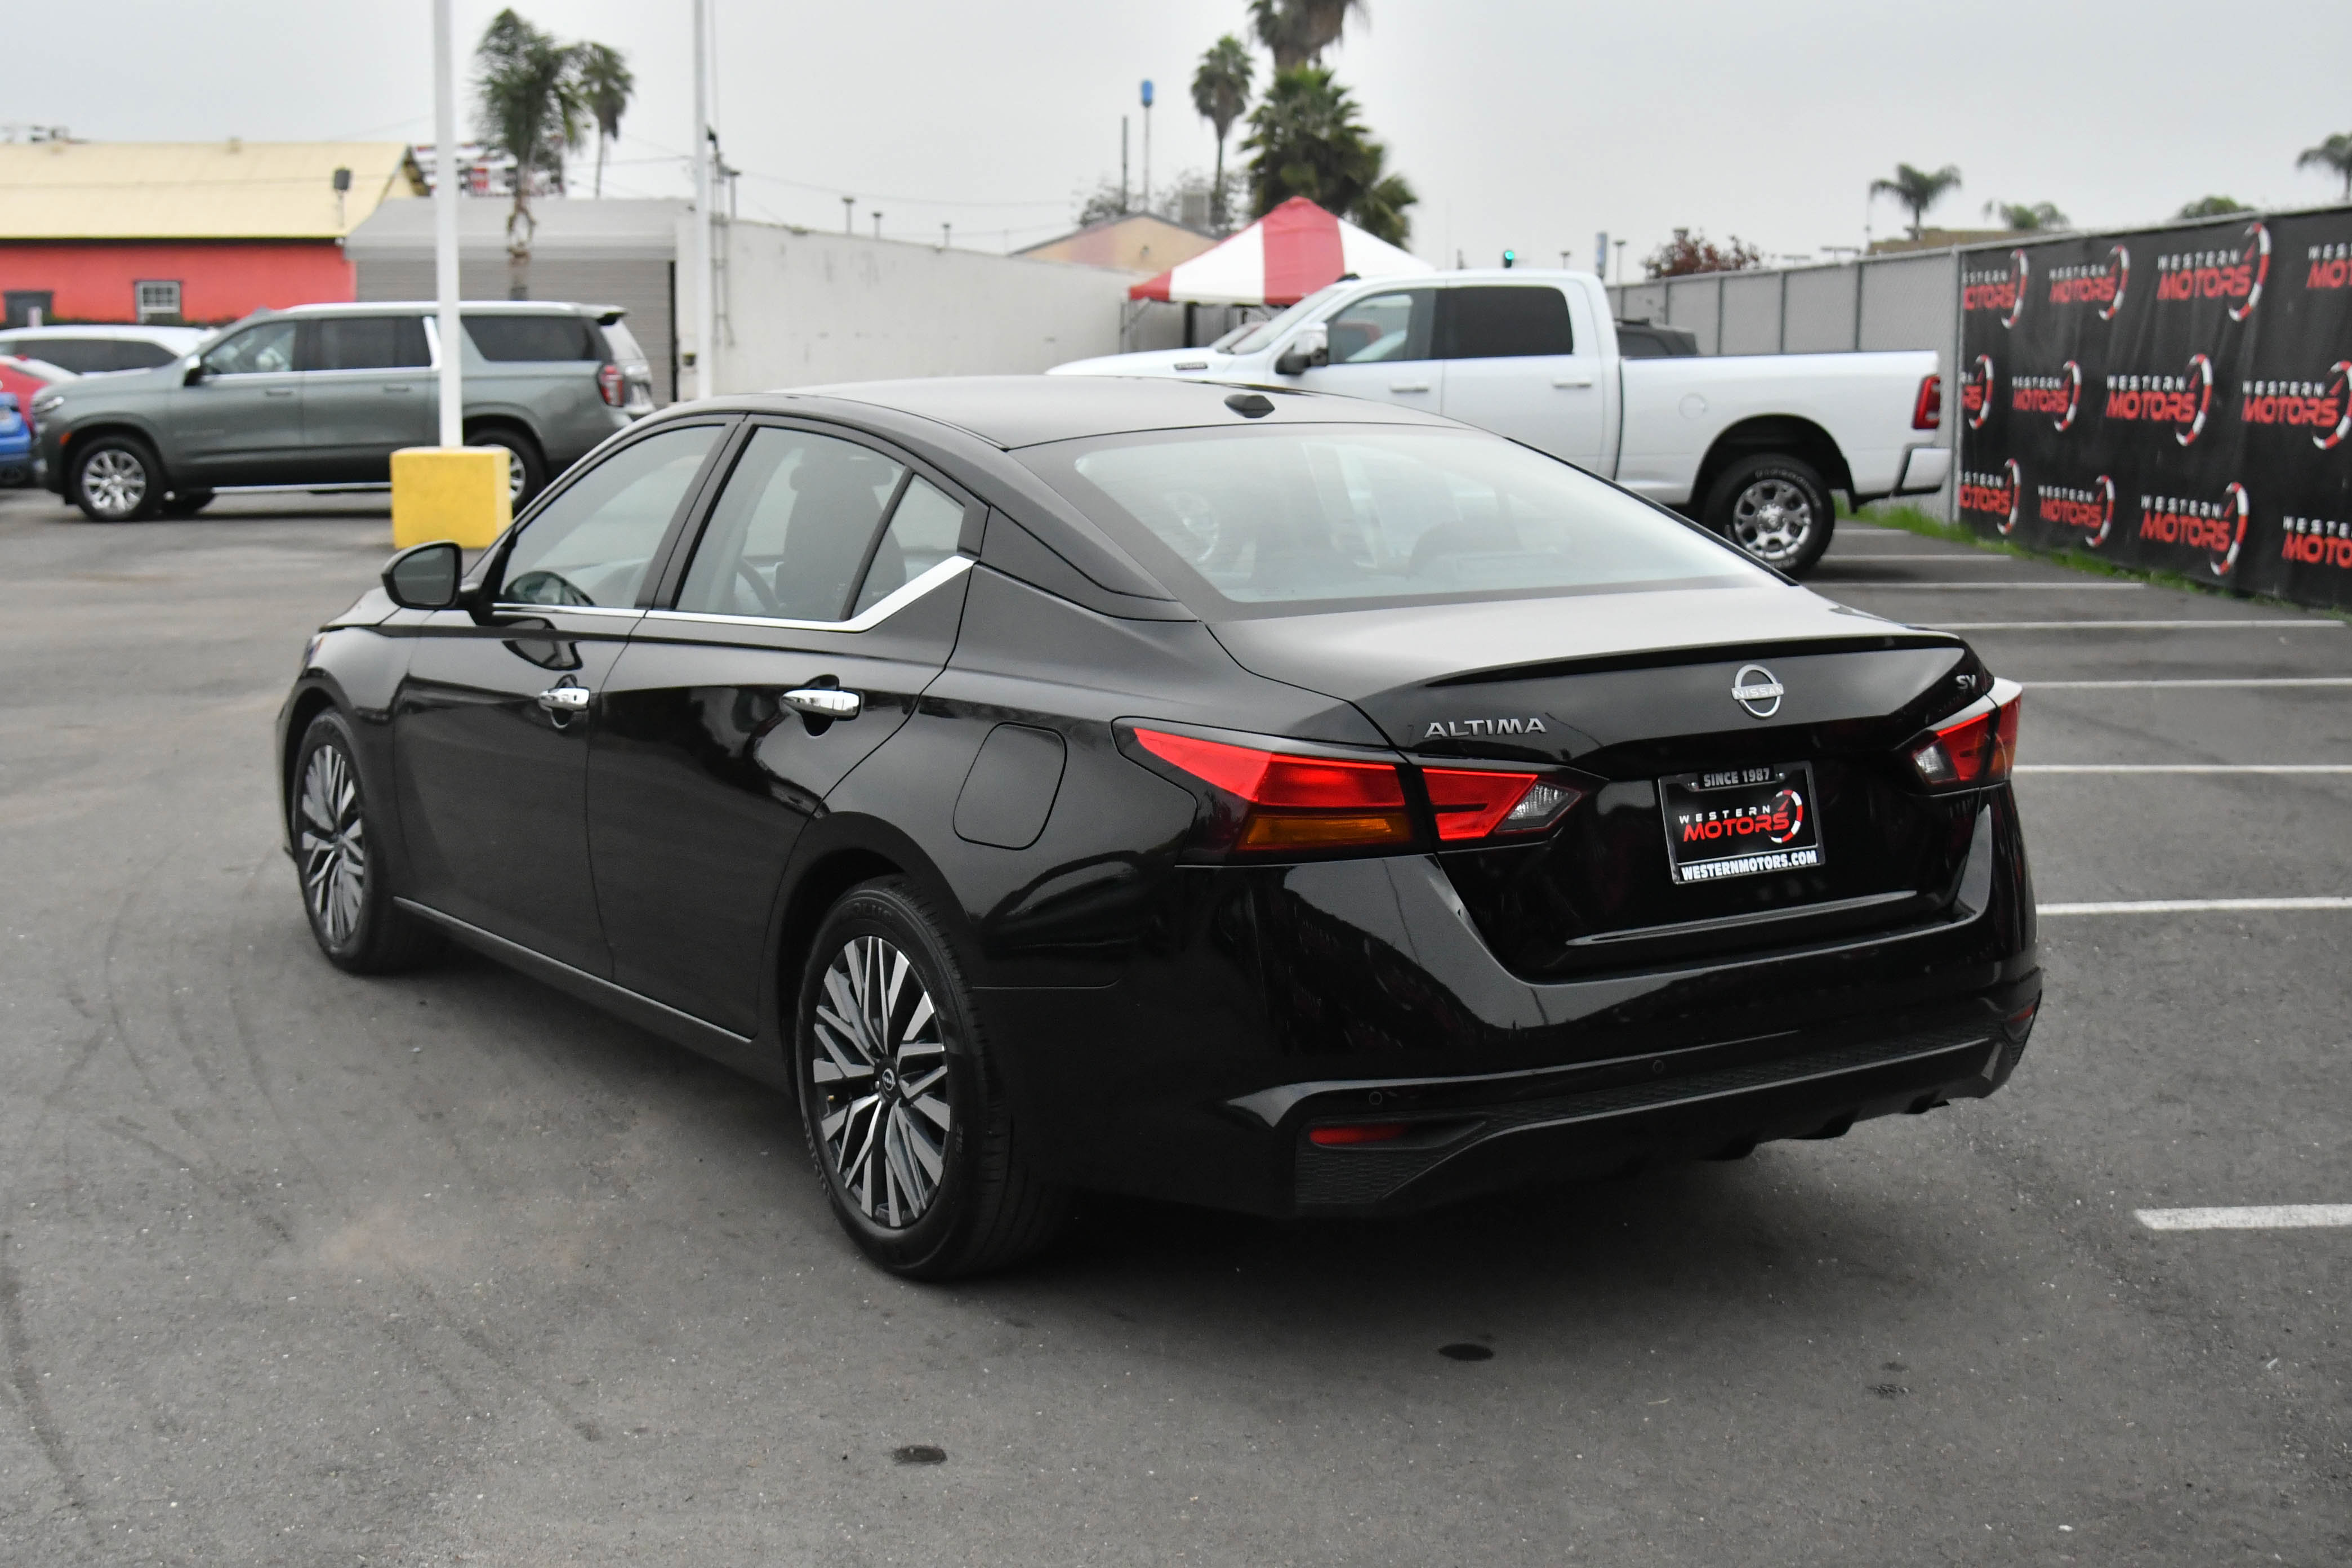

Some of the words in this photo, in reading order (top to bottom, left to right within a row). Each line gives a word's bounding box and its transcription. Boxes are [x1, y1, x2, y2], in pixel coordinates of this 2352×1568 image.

[2157, 250, 2239, 269] WESTERN
[2309, 244, 2352, 259] WES
[2050, 277, 2115, 302] MOTORS
[2157, 264, 2253, 299] MOTORS
[2107, 376, 2185, 391] WESTERN
[2243, 381, 2324, 396] WESTERN
[2012, 390, 2069, 412] MOTORS
[2106, 391, 2195, 421] MOTORS
[2242, 395, 2340, 426] MOTORS
[2040, 498, 2102, 528] MOTORS
[2141, 495, 2222, 518] WESTERN
[2140, 510, 2230, 551] MOTORS
[2283, 516, 2352, 537] WESTE
[1734, 686, 1784, 698] NISSAN
[1424, 718, 1547, 738] ALTIMA
[1704, 772, 1738, 787] SINCE
[1742, 768, 1769, 782] 1987
[1679, 805, 1770, 823] WESTERN
[1683, 812, 1789, 841] MOTORS
[1681, 850, 1816, 880] WESTERNMOTORS.COM
